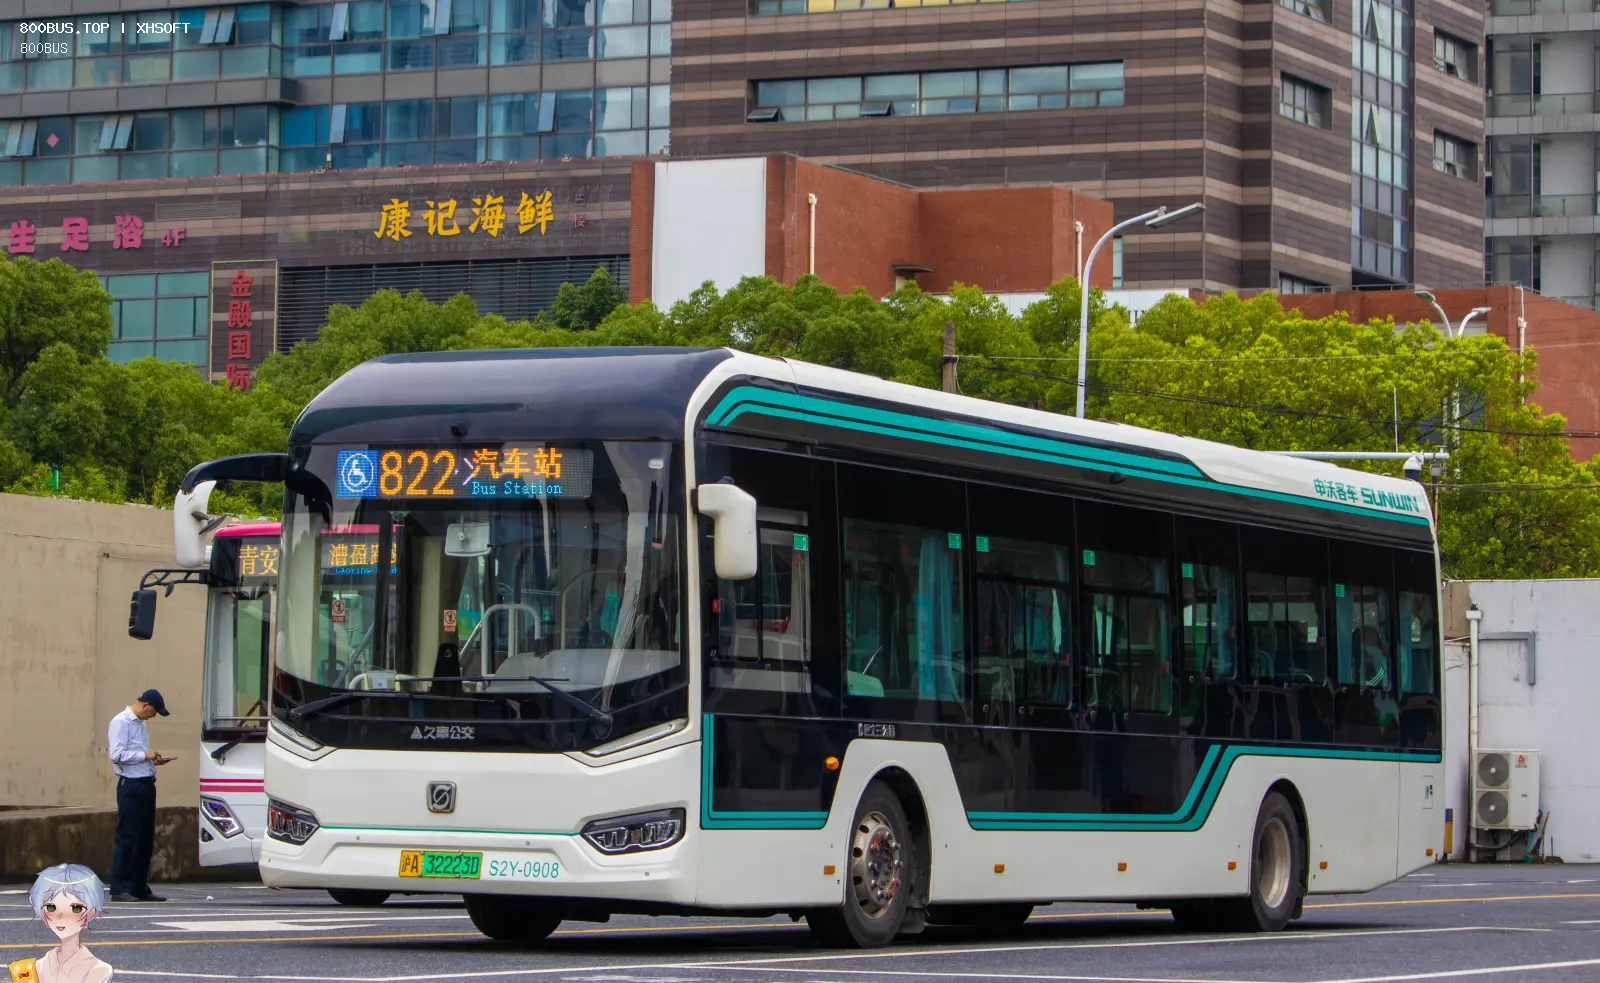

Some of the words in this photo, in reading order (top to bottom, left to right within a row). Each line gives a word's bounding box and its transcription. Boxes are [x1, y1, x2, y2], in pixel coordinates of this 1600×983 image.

[374, 190, 555, 241] 康记海鲜
[8, 215, 143, 254] 生足浴
[161, 228, 187, 247] 4F
[226, 269, 253, 391] 金殿国际
[380, 450, 456, 496] 822
[472, 447, 563, 480] 汽车站
[471, 481, 496, 495] Bus
[503, 481, 563, 495] Station
[1313, 477, 1358, 503] 申沃客车
[1361, 486, 1420, 513] SUNWIN
[238, 544, 279, 575] 青安
[489, 859, 559, 878] S2Y-0908
